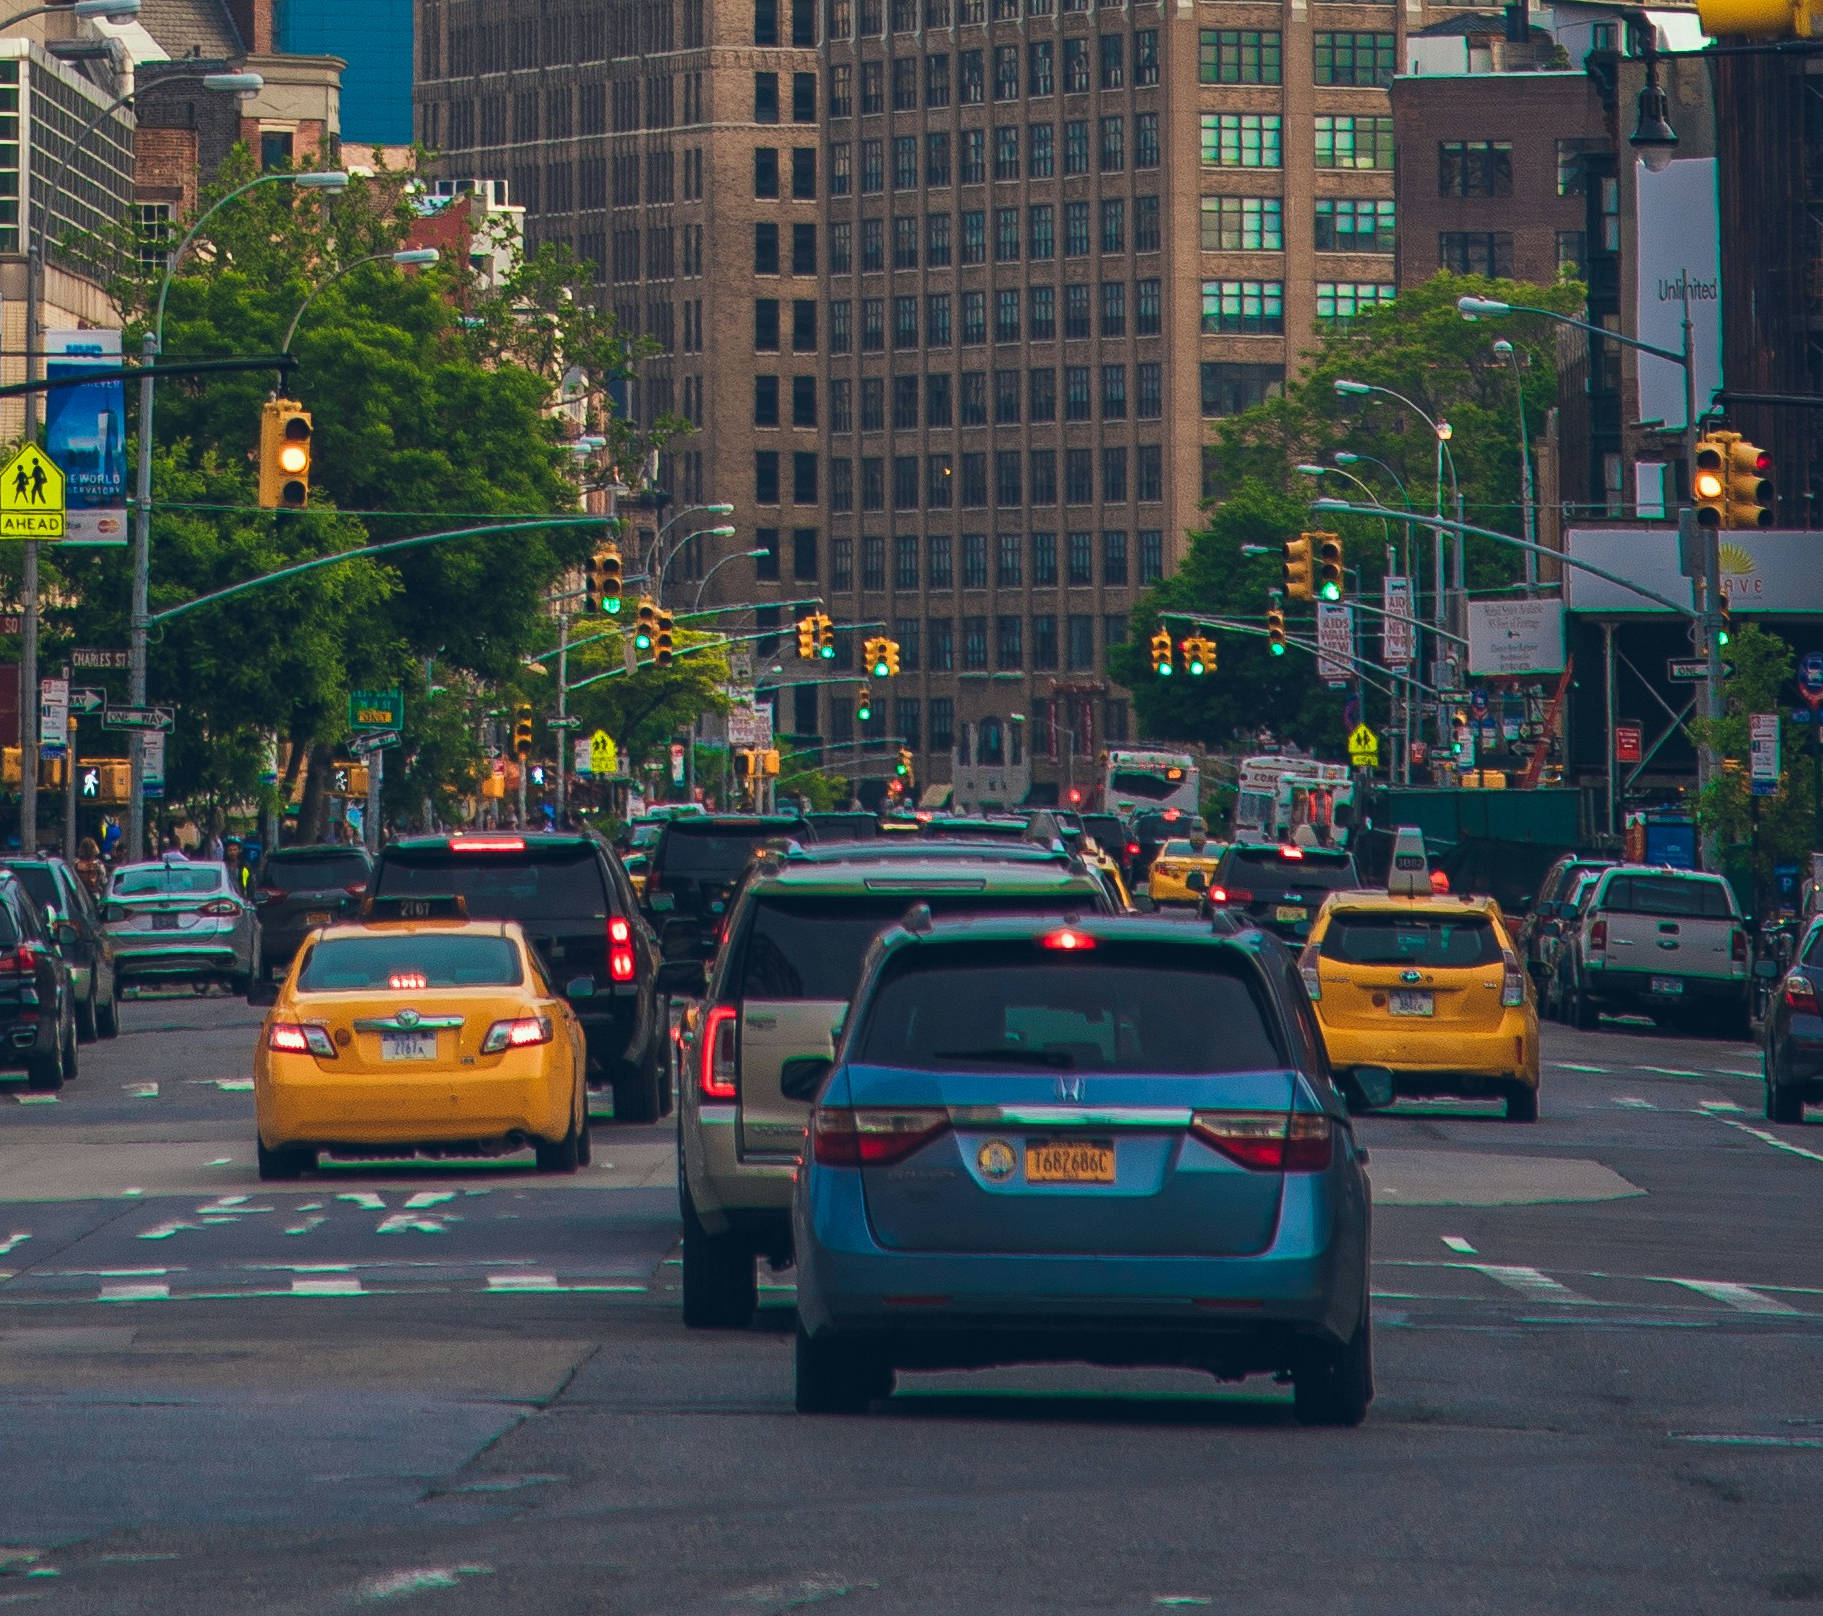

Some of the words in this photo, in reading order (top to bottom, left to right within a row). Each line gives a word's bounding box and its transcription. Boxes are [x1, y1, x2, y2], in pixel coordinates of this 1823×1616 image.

[80, 473, 120, 485] WORLD
[5, 518, 59, 530] AHEAD
[73, 652, 111, 667] CHARLES
[115, 652, 126, 667] ST
[1679, 666, 1699, 675] ONE
[142, 713, 164, 725] WAY
